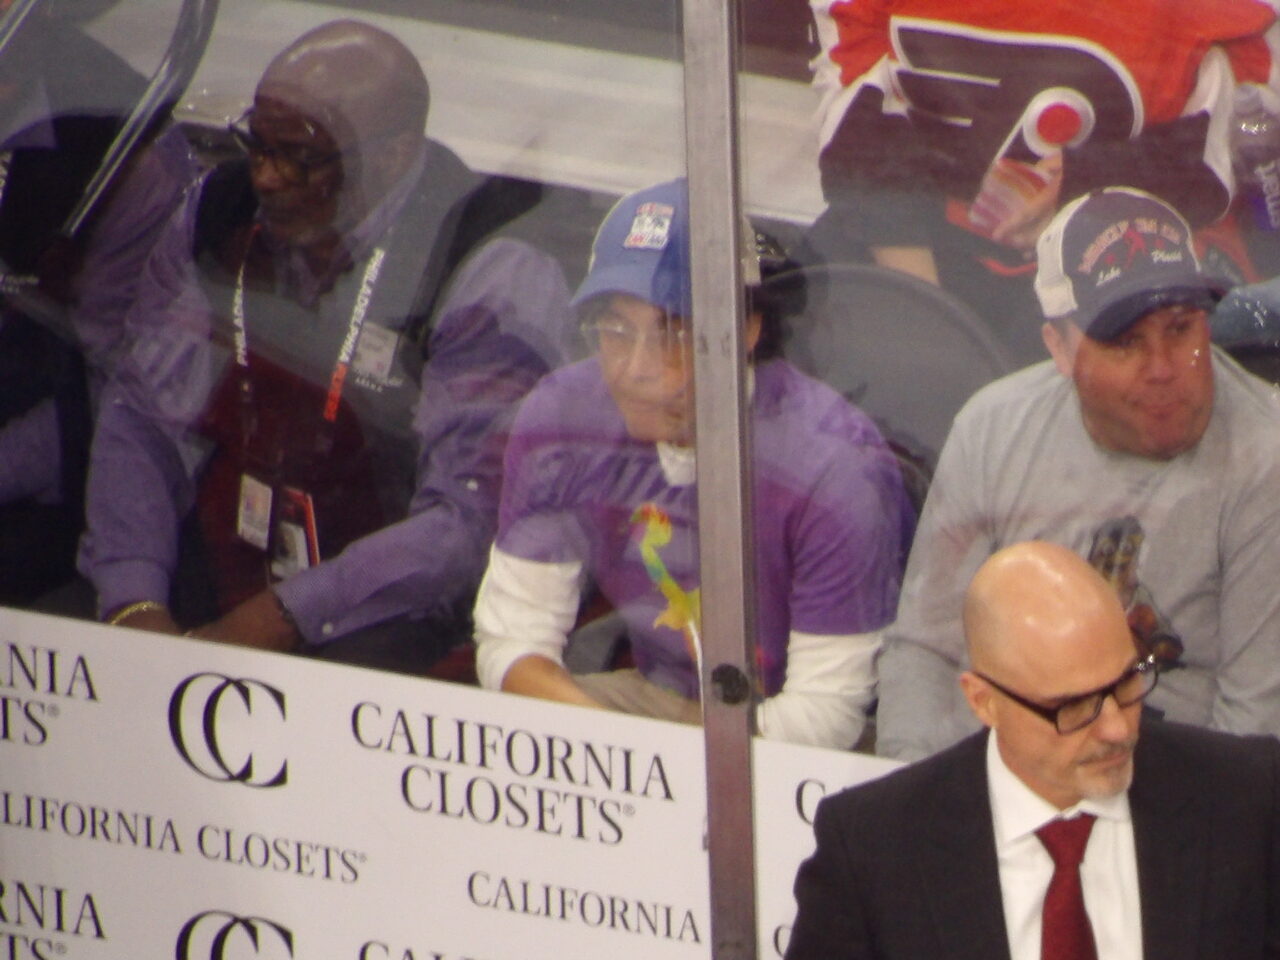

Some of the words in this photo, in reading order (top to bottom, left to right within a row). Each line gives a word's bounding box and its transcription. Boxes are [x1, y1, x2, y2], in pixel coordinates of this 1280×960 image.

[351, 701, 674, 801] CALIFORNIA
[1, 792, 182, 854] LIFORNIA
[467, 871, 702, 944] CALIFORNIA
